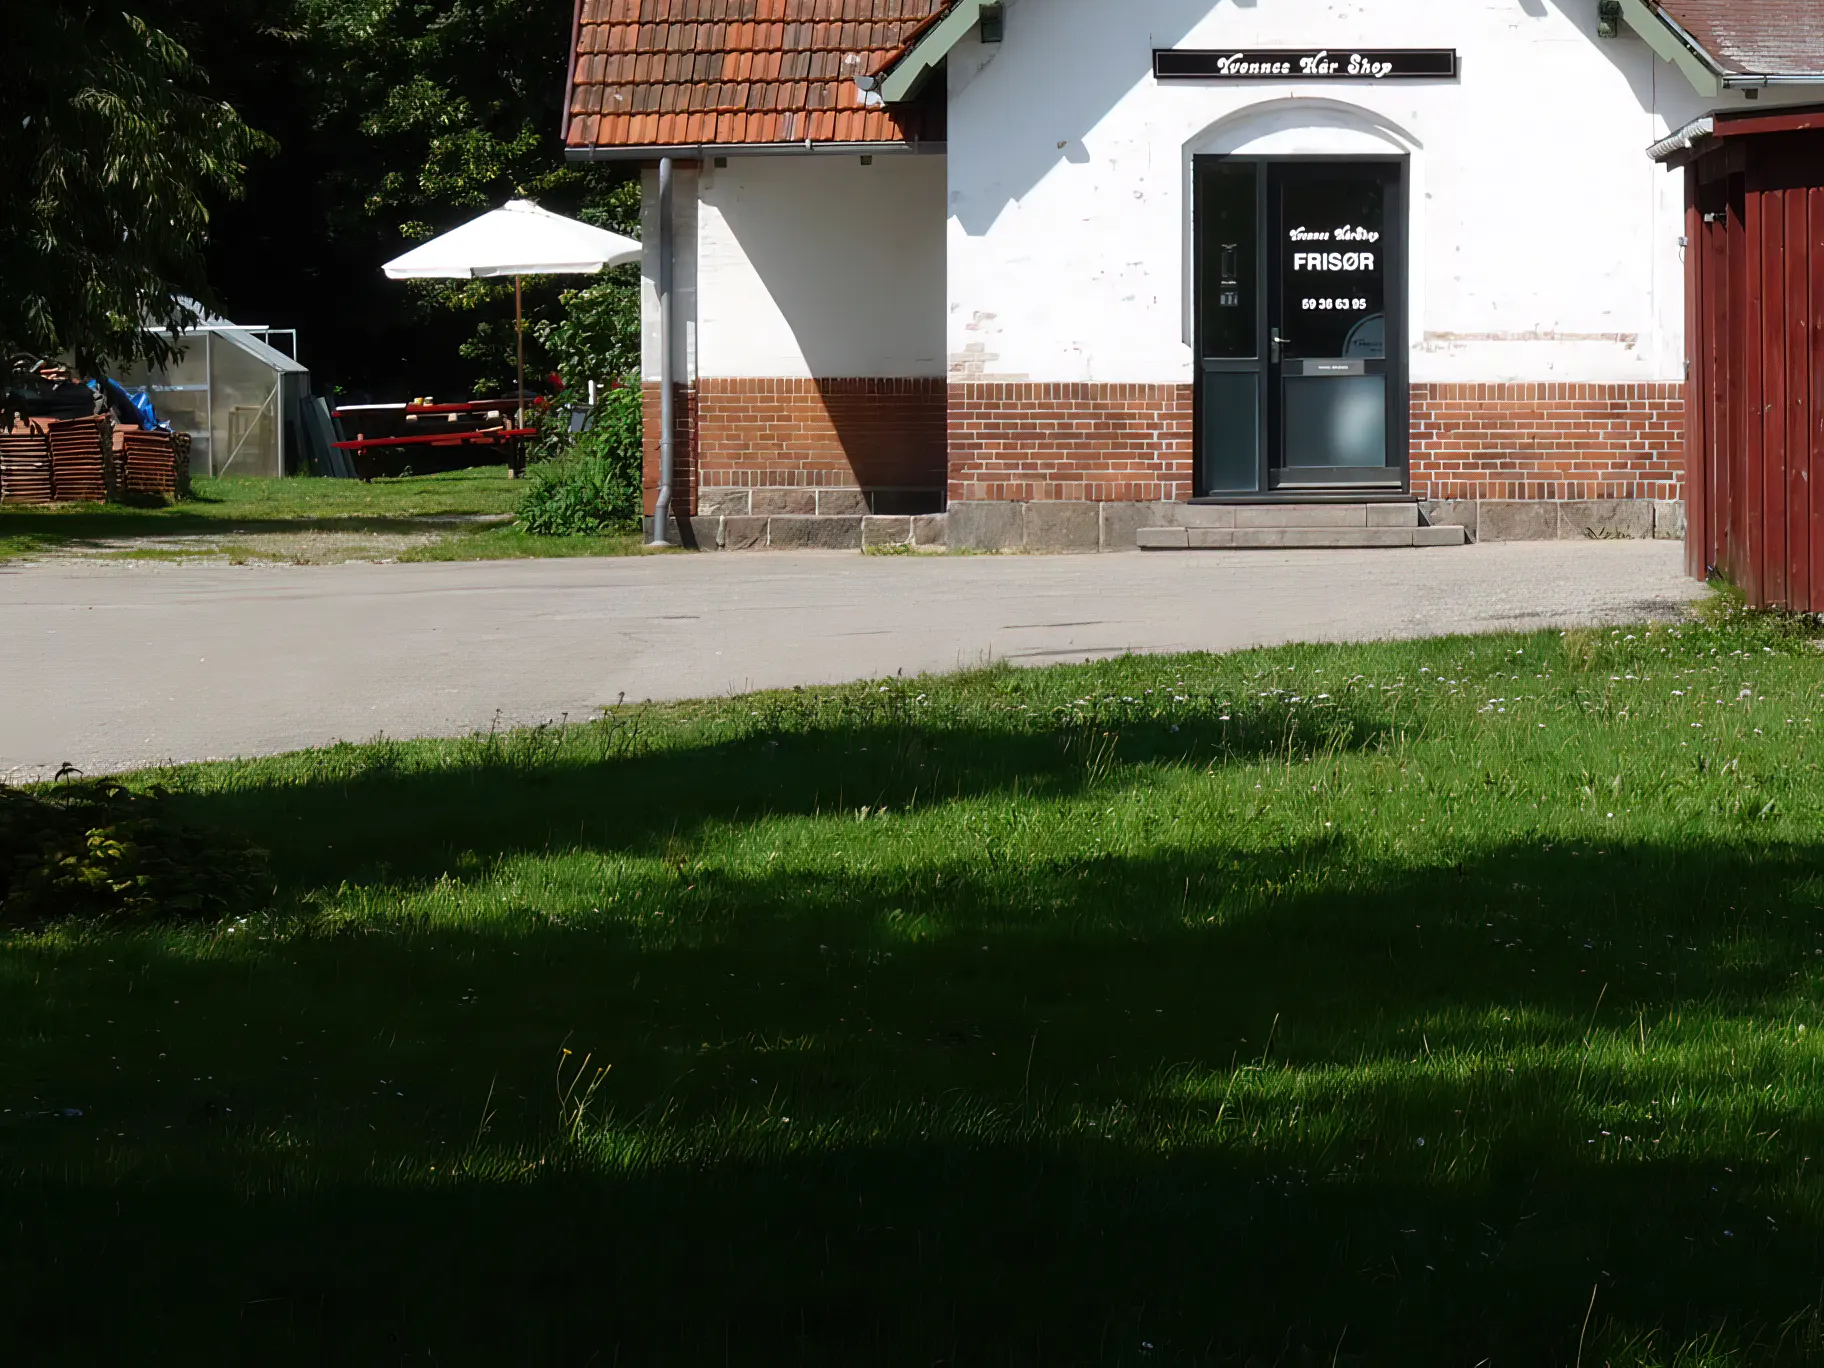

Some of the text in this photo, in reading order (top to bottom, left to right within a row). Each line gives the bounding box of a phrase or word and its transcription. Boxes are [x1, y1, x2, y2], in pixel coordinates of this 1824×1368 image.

[1217, 50, 1393, 78] Yvonnes Hår Shop
[1293, 252, 1374, 271] FRISØR
[1335, 298, 1350, 310] 63
